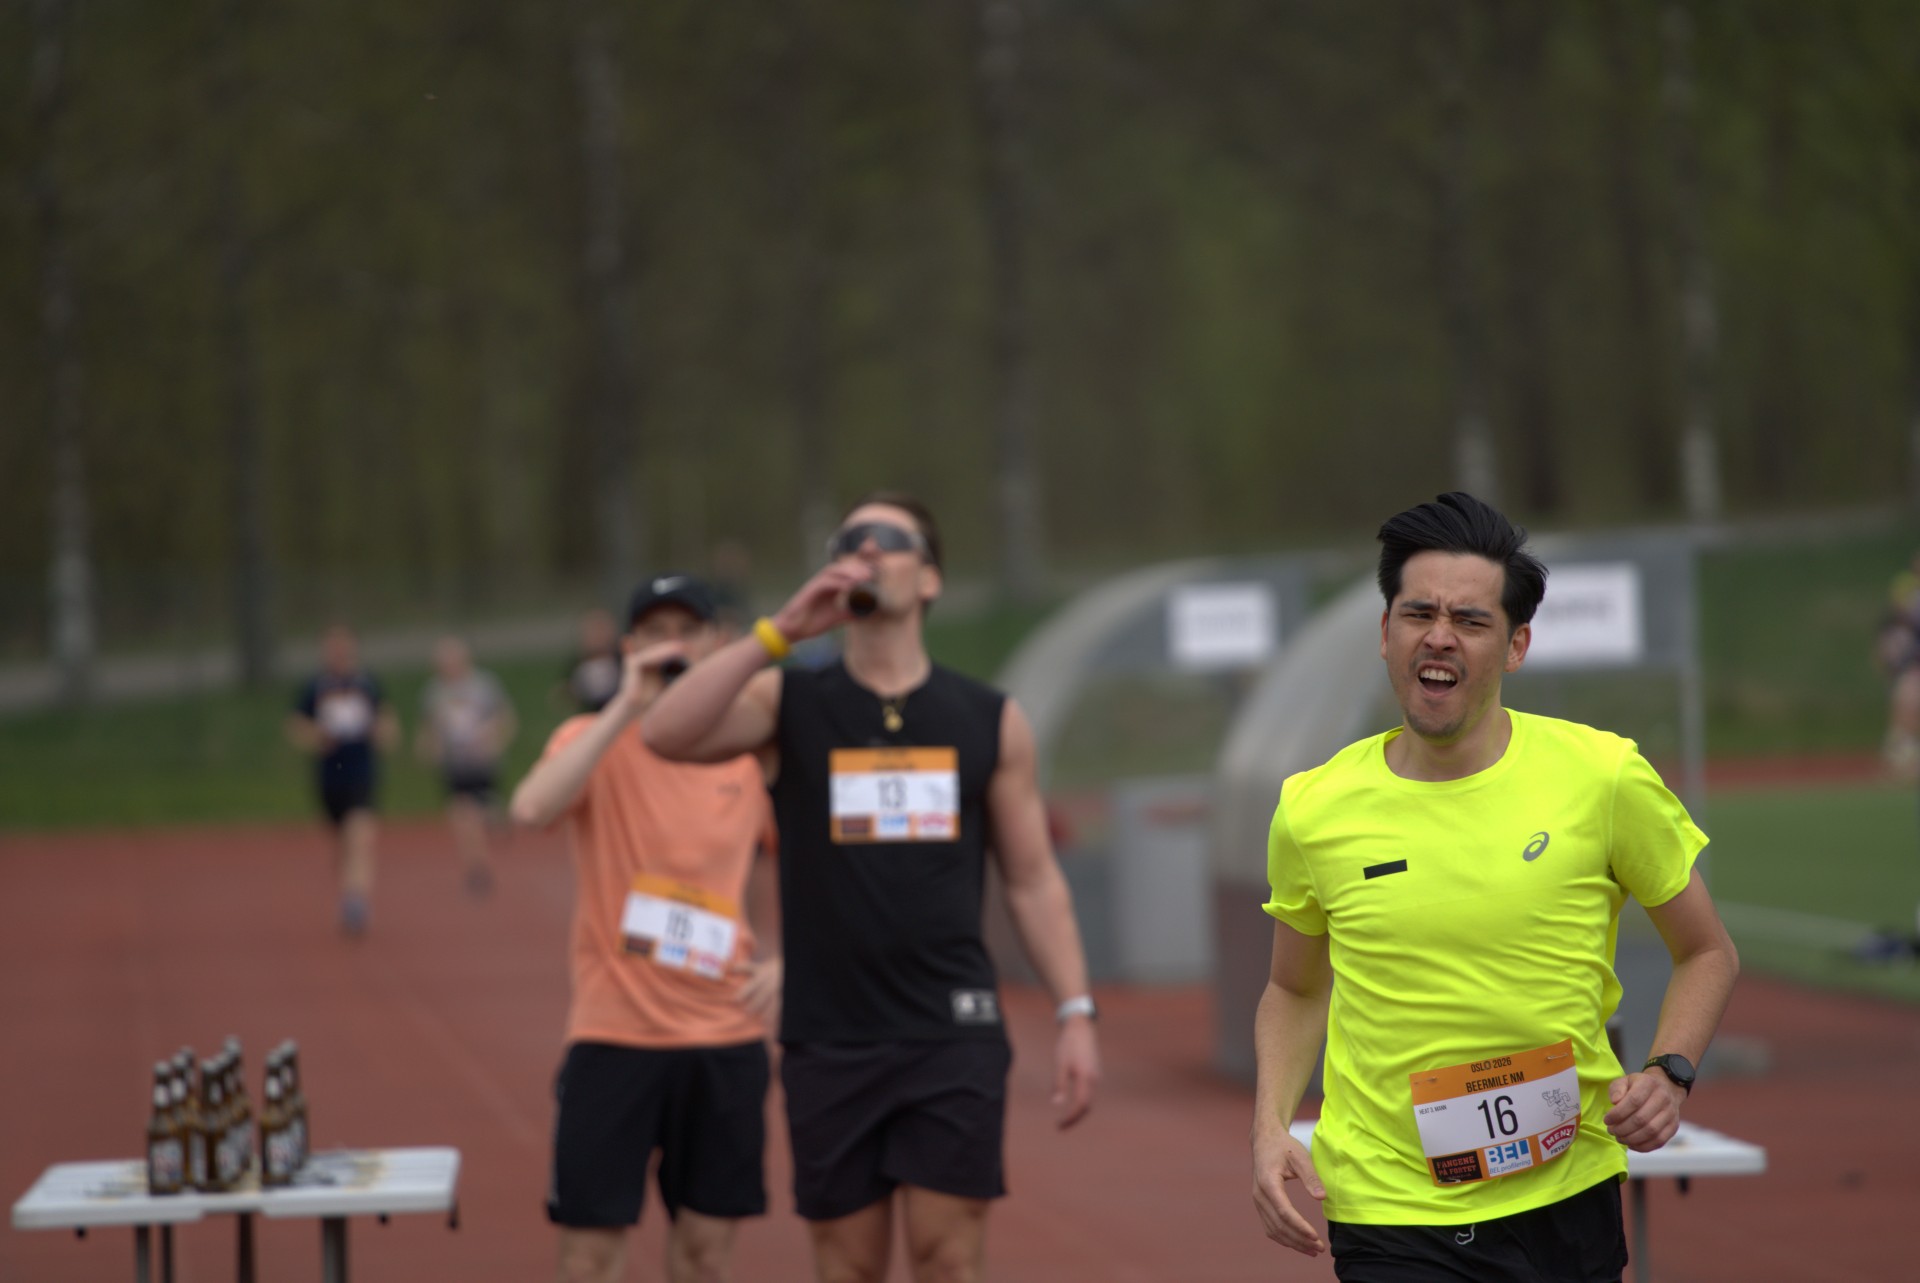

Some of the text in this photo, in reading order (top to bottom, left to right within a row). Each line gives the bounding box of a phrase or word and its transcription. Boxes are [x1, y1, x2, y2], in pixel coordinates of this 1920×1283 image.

[1471, 1056, 1512, 1073] OSLO 2026
[1465, 1071, 1525, 1093] BEERMILE NM
[1434, 1104, 1447, 1112] MANN
[1477, 1095, 1519, 1139] 16
[1545, 1127, 1573, 1147] MENY
[1487, 1139, 1530, 1164] BEL
[1436, 1155, 1475, 1169] FANGENE
[1449, 1164, 1477, 1175] FORTET
[1490, 1159, 1532, 1175] BEL profilering
